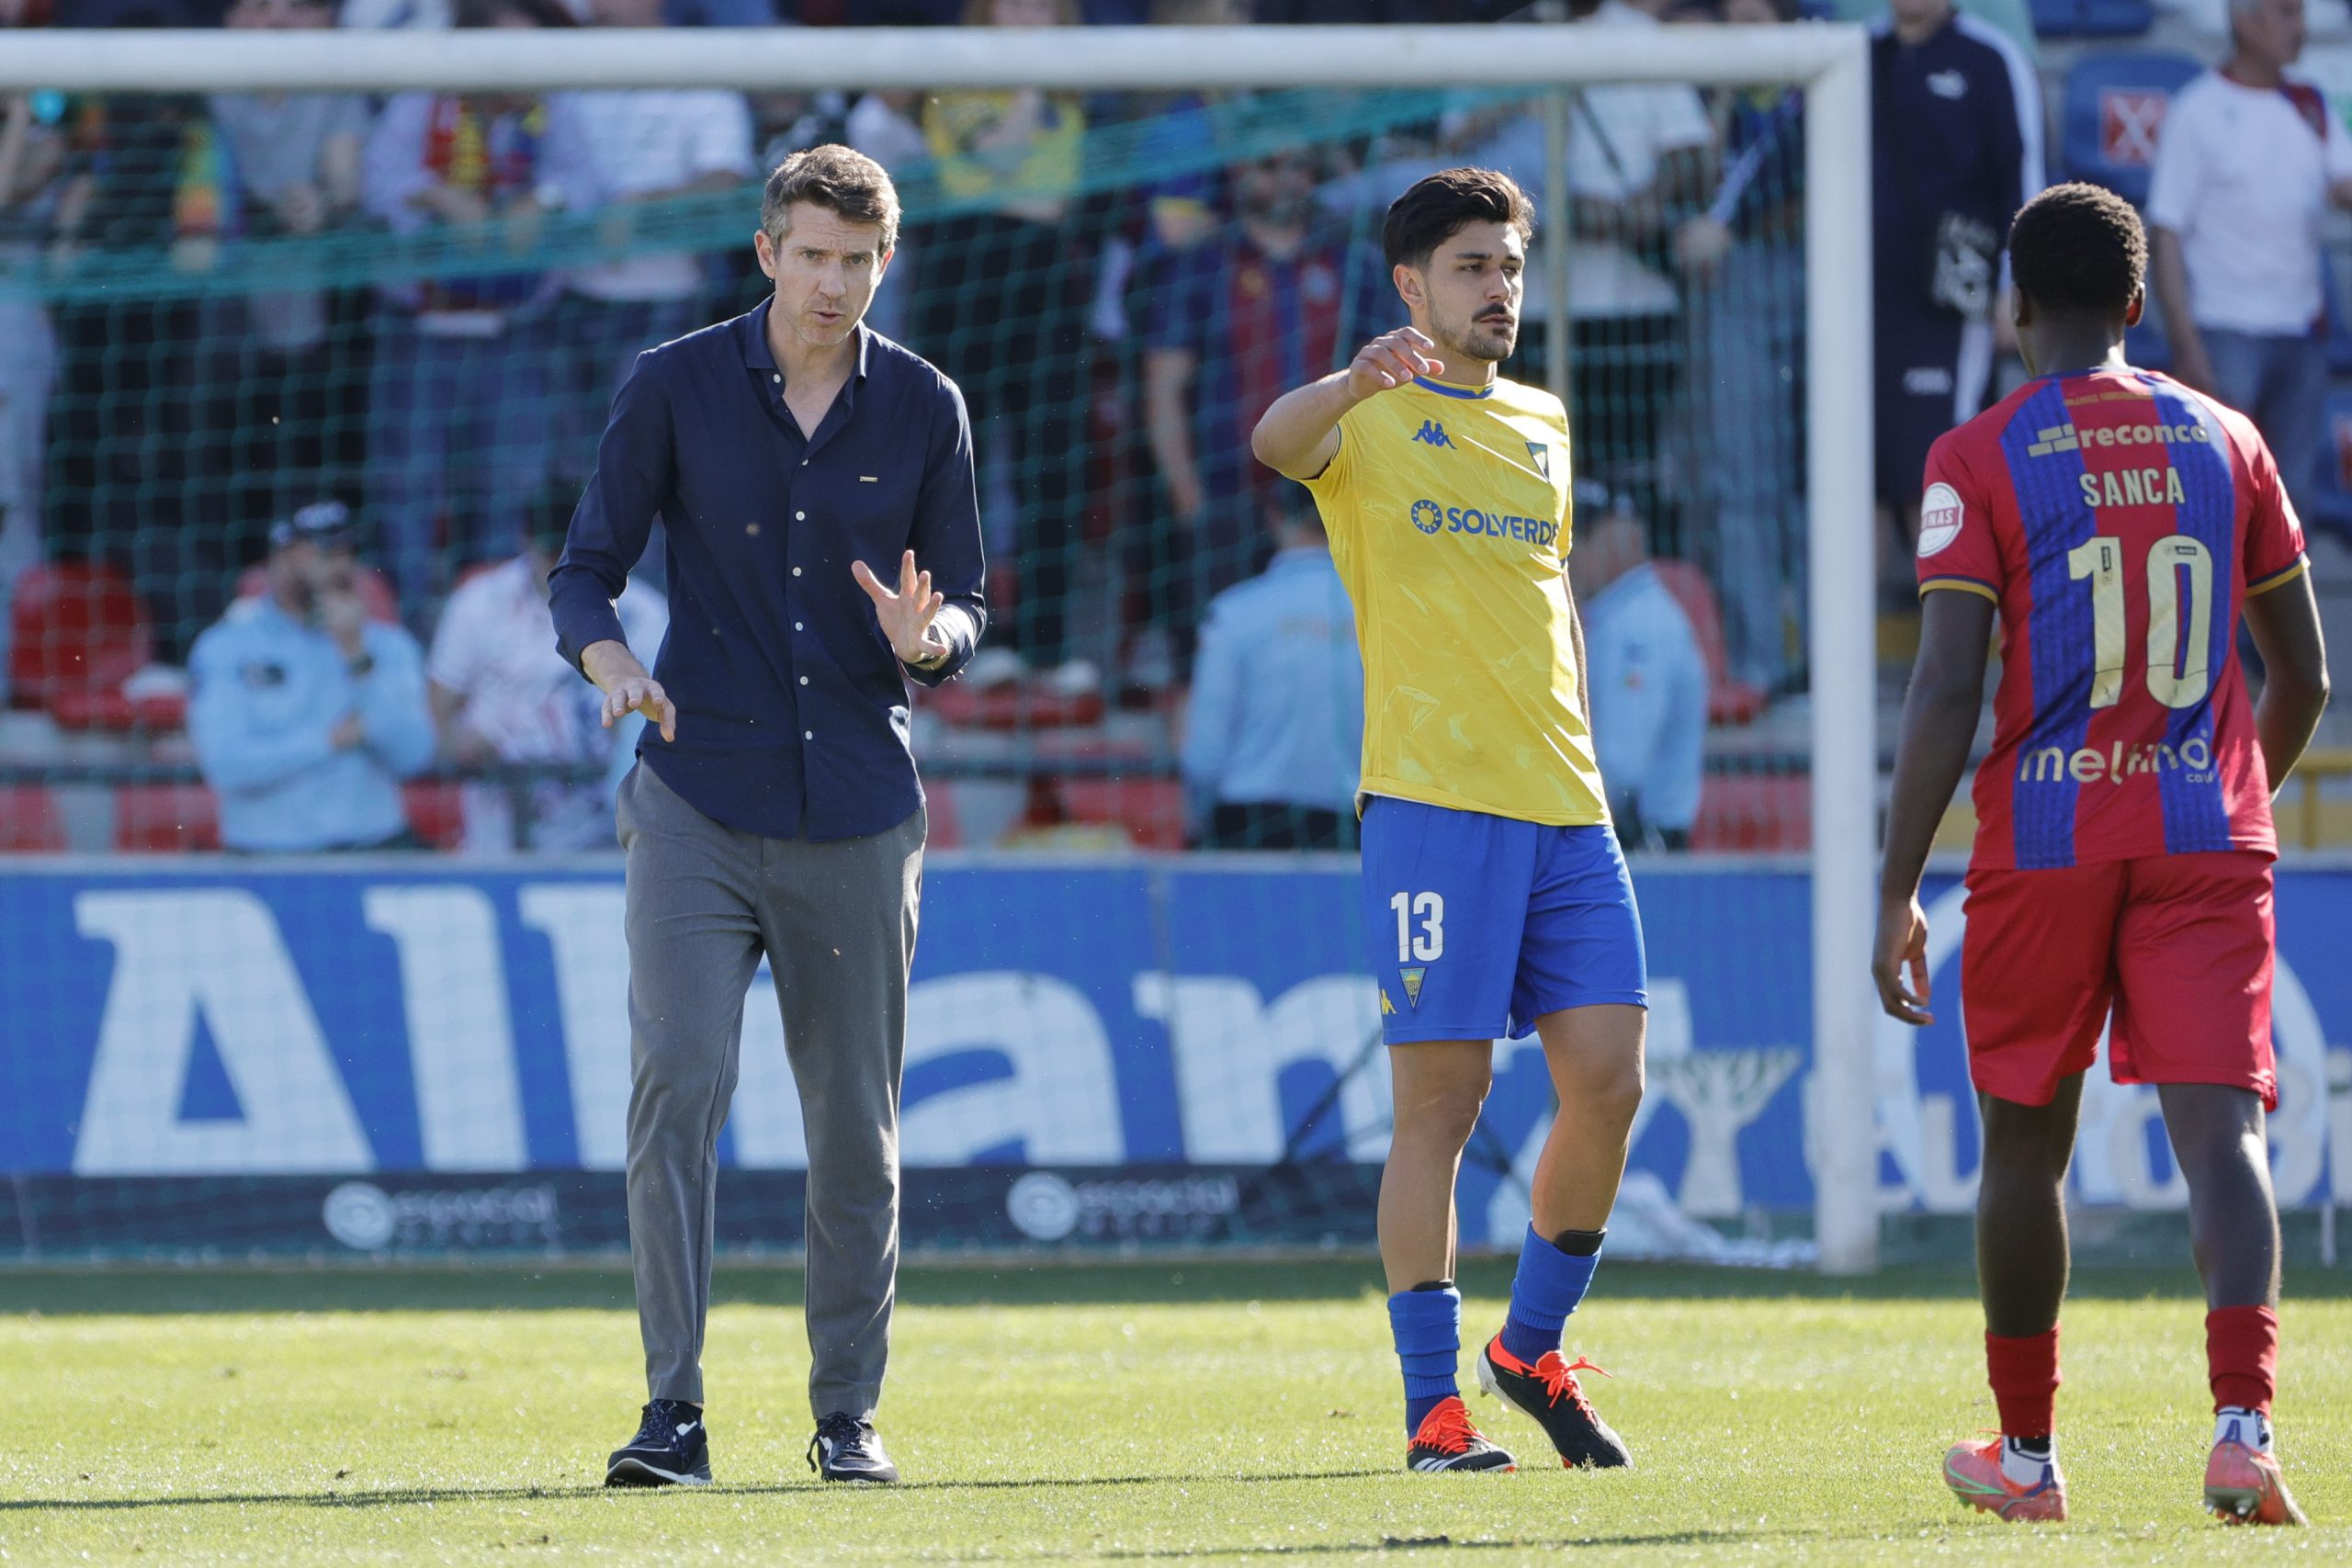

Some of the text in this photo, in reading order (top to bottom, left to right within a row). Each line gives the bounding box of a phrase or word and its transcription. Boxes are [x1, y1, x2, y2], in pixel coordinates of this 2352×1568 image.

[2079, 468, 2185, 507] SANCA
[2067, 535, 2212, 709] 10
[1390, 891, 1444, 963] 13
